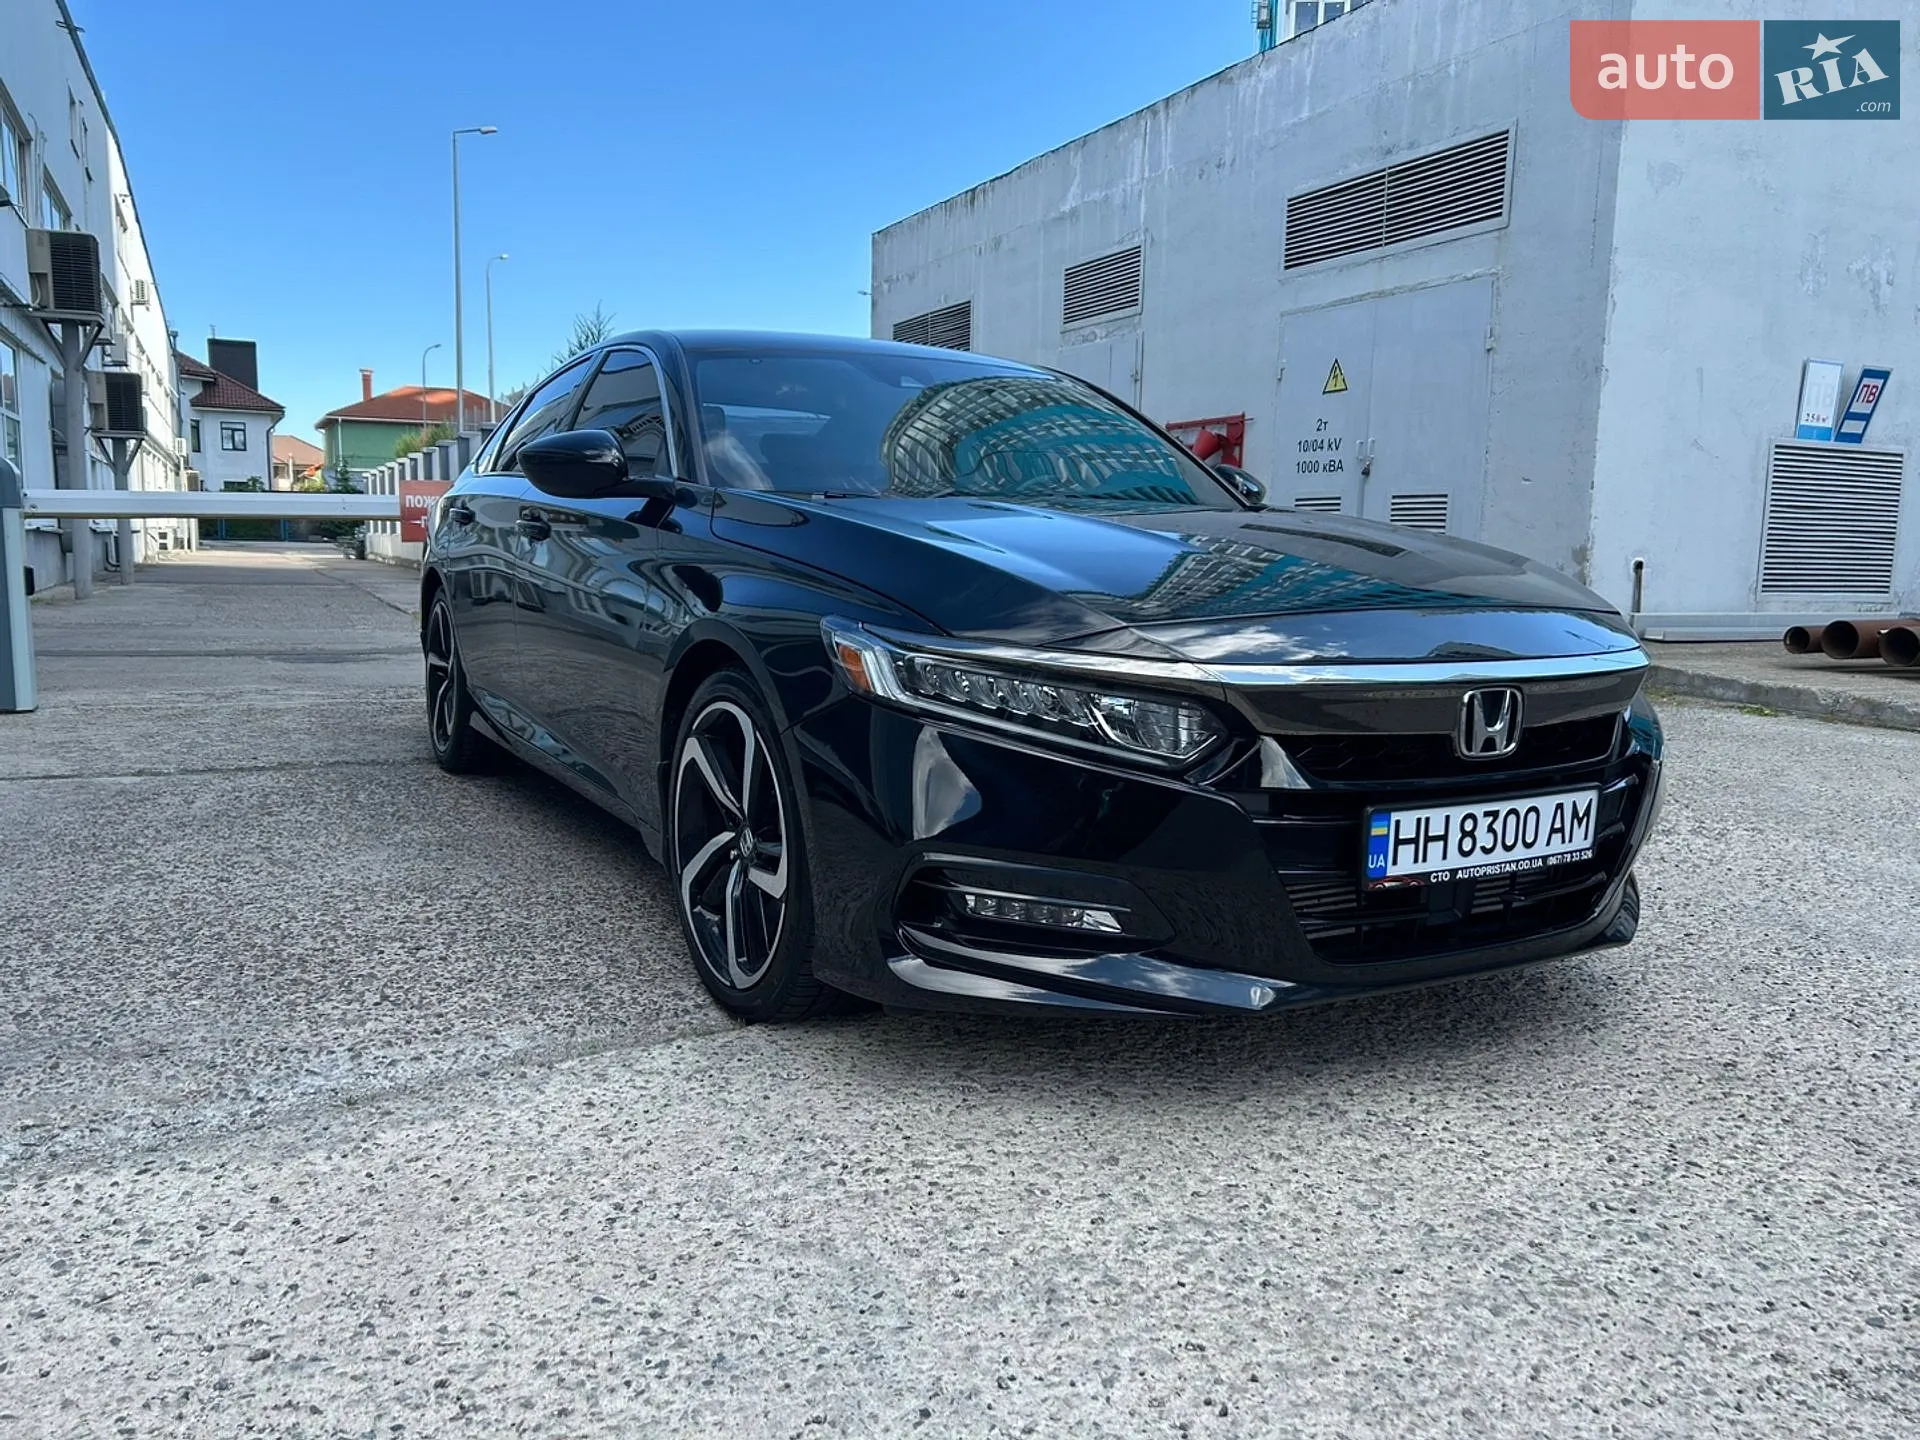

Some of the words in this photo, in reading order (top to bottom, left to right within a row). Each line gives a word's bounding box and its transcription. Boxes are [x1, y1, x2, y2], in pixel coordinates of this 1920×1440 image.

[1856, 384, 1879, 404] ПВ
[1297, 440, 1324, 453] 10/04
[1296, 460, 1320, 474] 1000
[1391, 814, 1451, 866] HH
[1457, 805, 1541, 858] 8300
[1545, 798, 1593, 847] AM
[1368, 854, 1385, 869] UA
